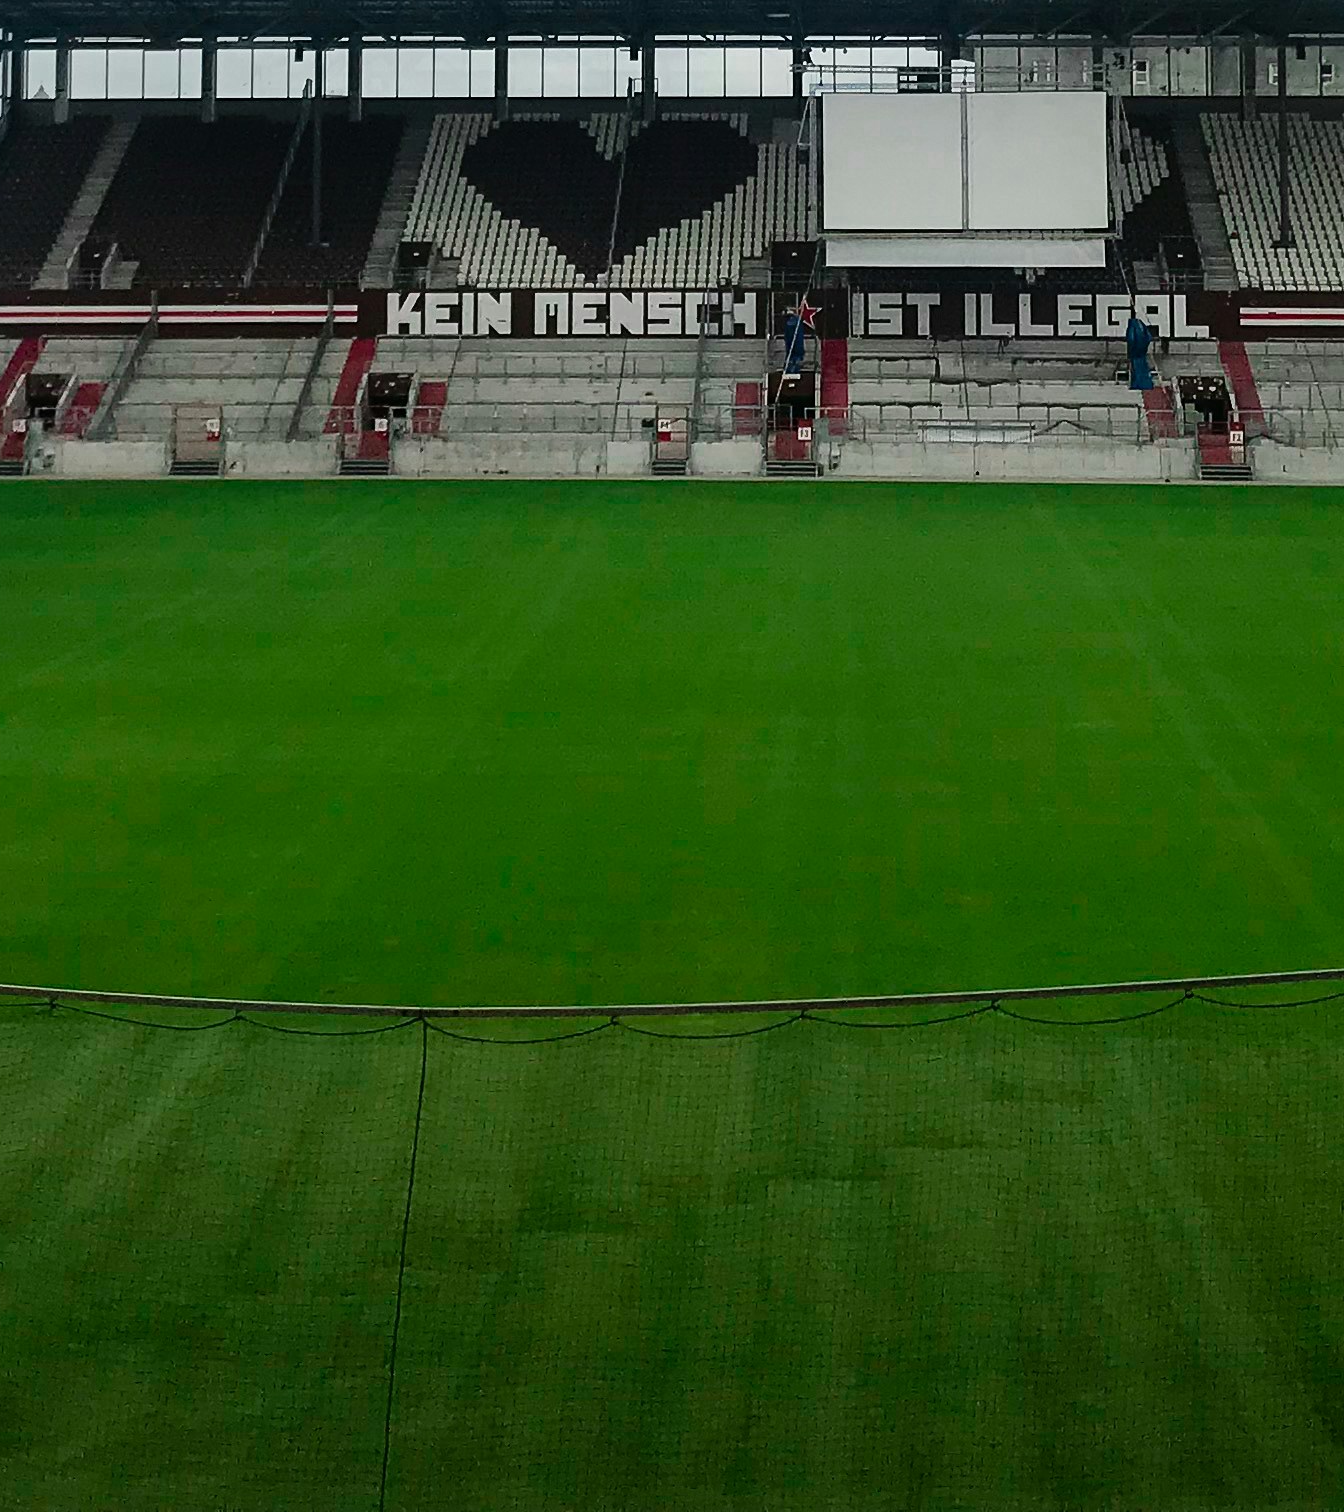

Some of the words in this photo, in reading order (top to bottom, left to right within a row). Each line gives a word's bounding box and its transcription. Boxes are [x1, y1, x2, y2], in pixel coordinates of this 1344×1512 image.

[387, 292, 512, 335] KEIN
[534, 292, 756, 336] MENSCH
[850, 292, 941, 337] IST
[964, 293, 1209, 338] ILLEGAL
